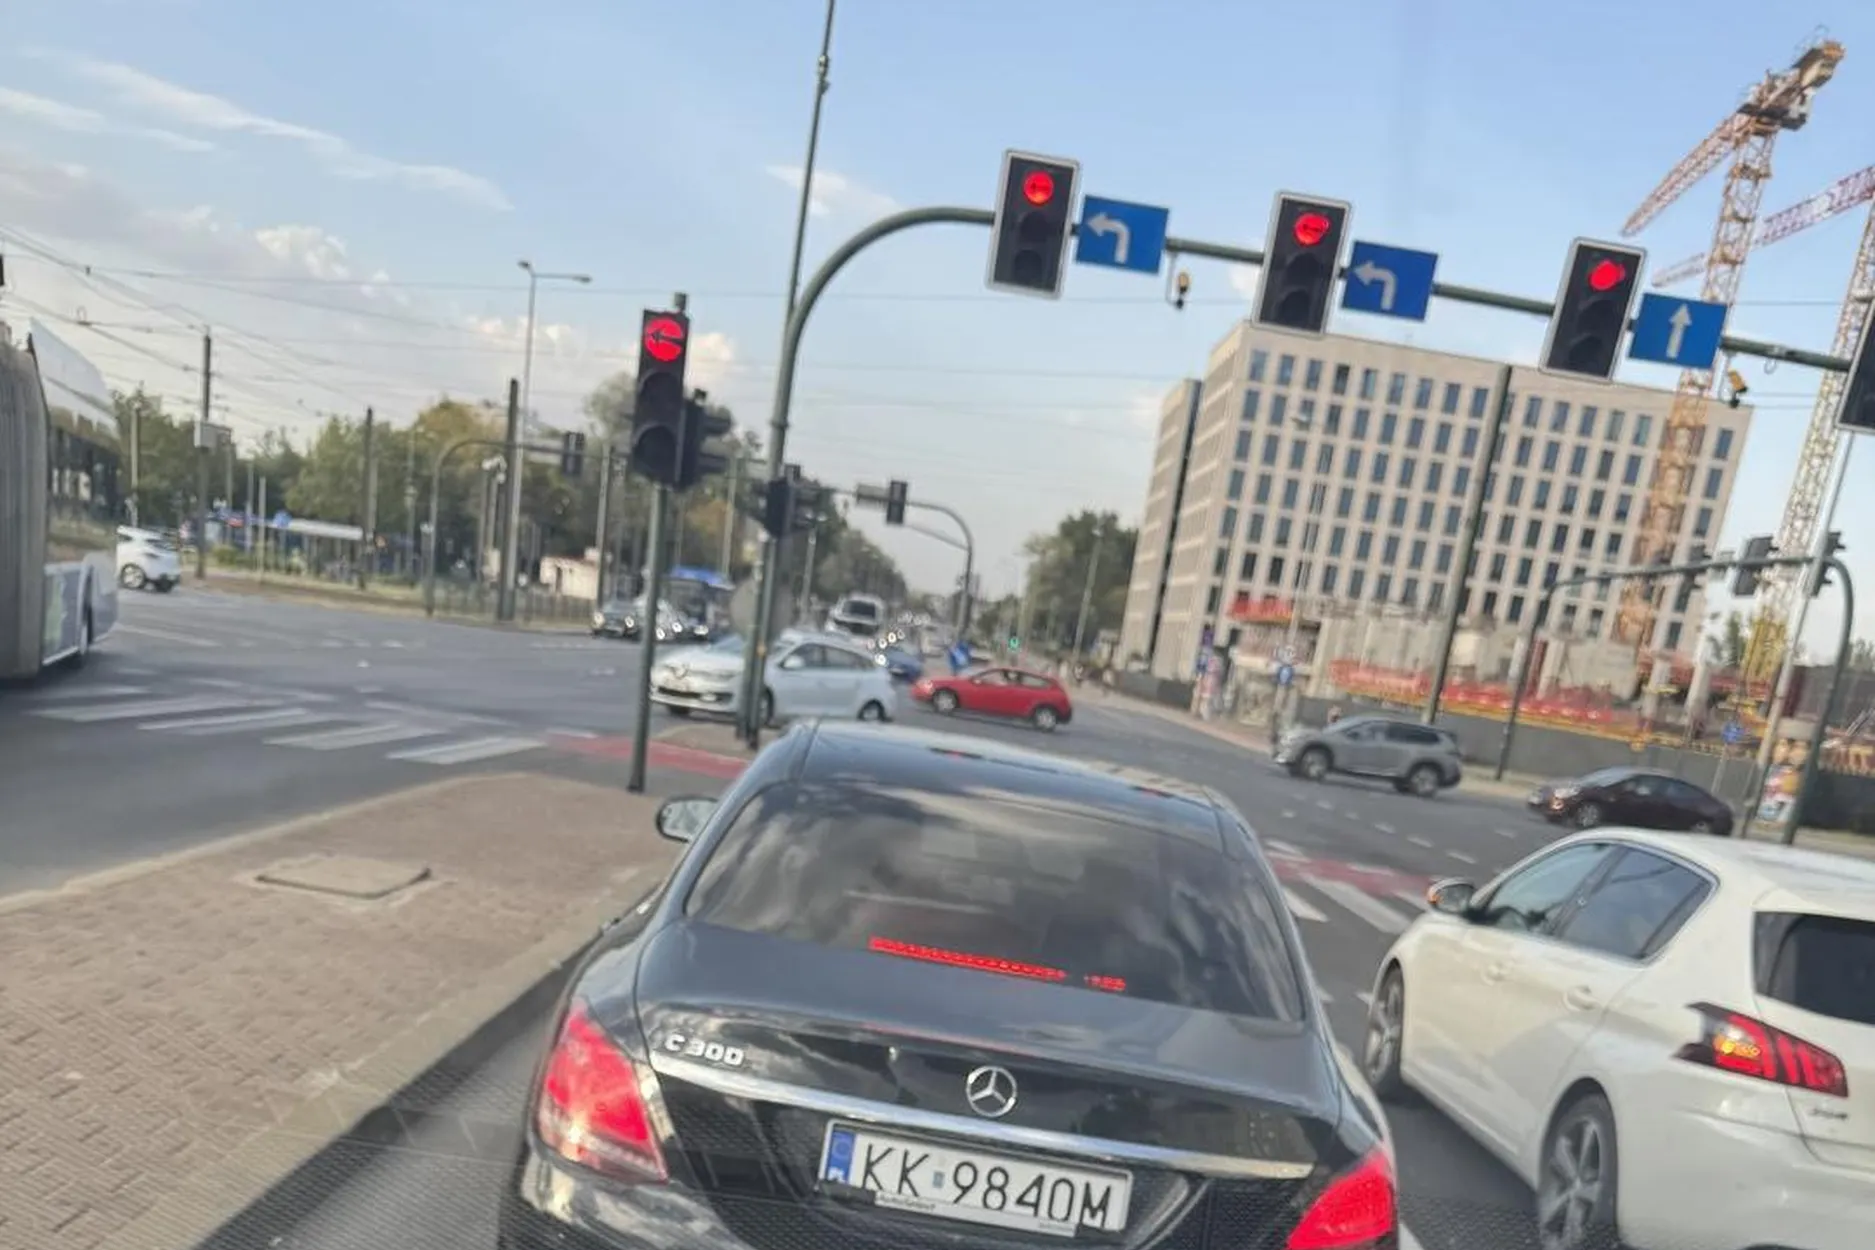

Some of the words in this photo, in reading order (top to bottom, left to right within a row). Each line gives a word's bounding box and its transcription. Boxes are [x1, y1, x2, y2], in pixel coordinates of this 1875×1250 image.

[664, 1033, 686, 1052] C
[684, 1037, 745, 1066] 300
[861, 1143, 931, 1198] KK
[953, 1161, 1112, 1230] 9840M
